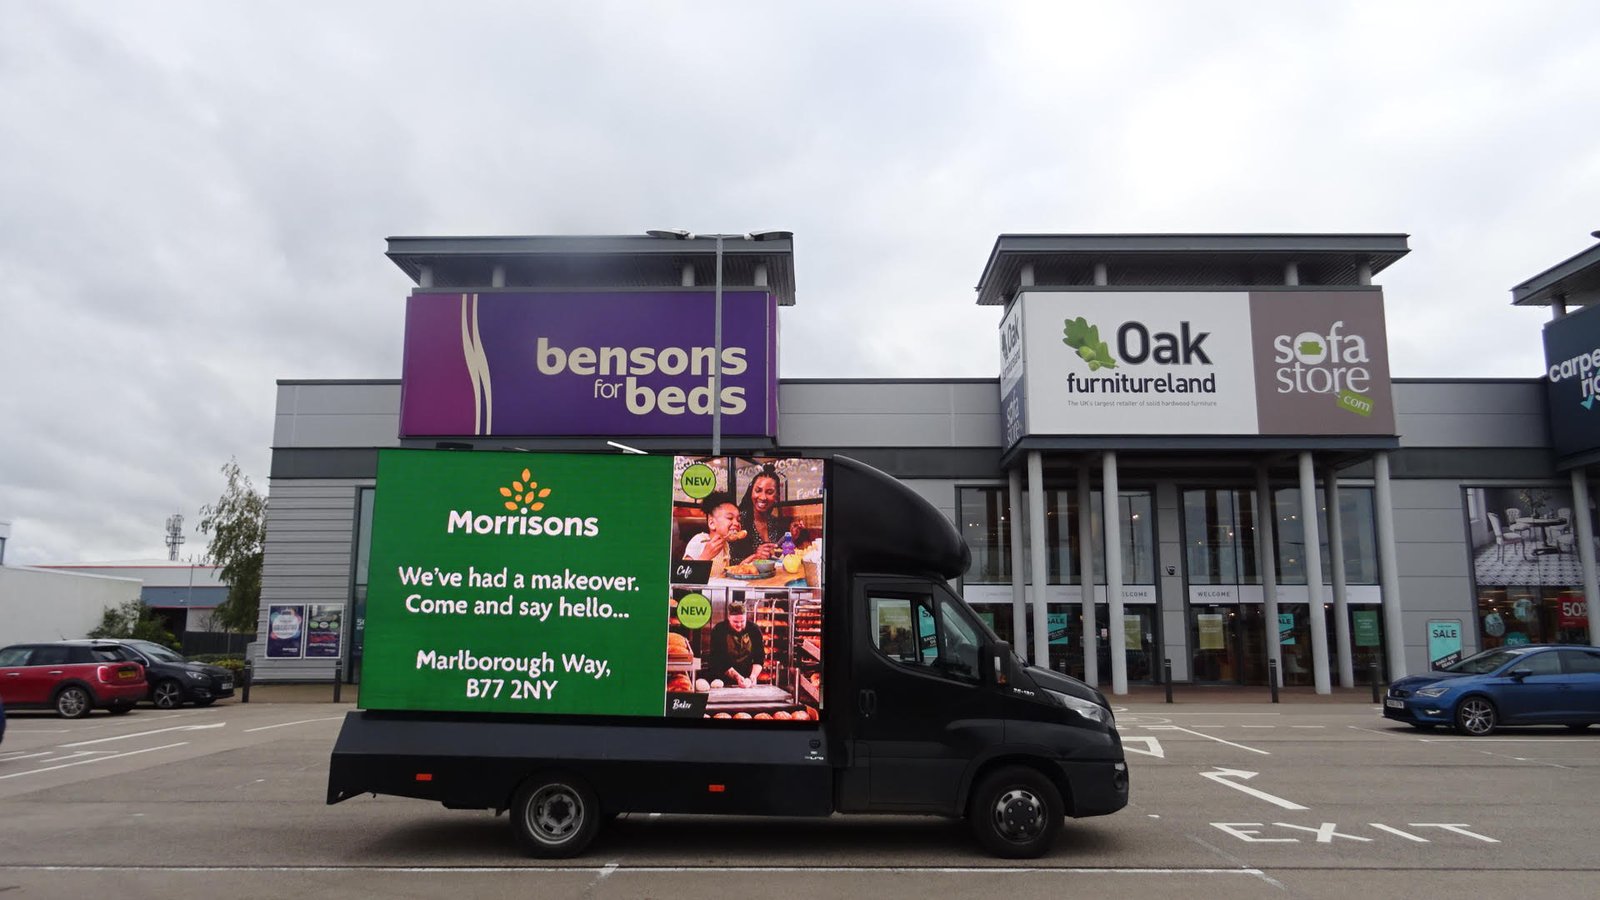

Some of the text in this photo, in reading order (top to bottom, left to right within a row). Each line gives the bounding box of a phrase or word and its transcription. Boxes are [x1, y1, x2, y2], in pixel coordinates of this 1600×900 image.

[1007, 313, 1020, 354] Oak
[1116, 320, 1213, 366] Oak
[1273, 320, 1369, 366] sofa
[536, 337, 747, 376] bensons
[1067, 372, 1216, 394] furnitureland
[1276, 362, 1370, 394] store
[594, 376, 746, 415] for beds
[1094, 400, 1115, 408] largest
[685, 476, 712, 487] NEW
[447, 507, 600, 537] Morrisons
[398, 566, 640, 592] We've had a makeover.
[405, 594, 629, 622] Come and say hello...
[680, 605, 708, 617] NEW
[1432, 629, 1457, 638] SALE
[416, 650, 611, 678] Marlborough Way,
[466, 679, 558, 700] B77 2NY
[1208, 822, 1501, 843] EXIT
